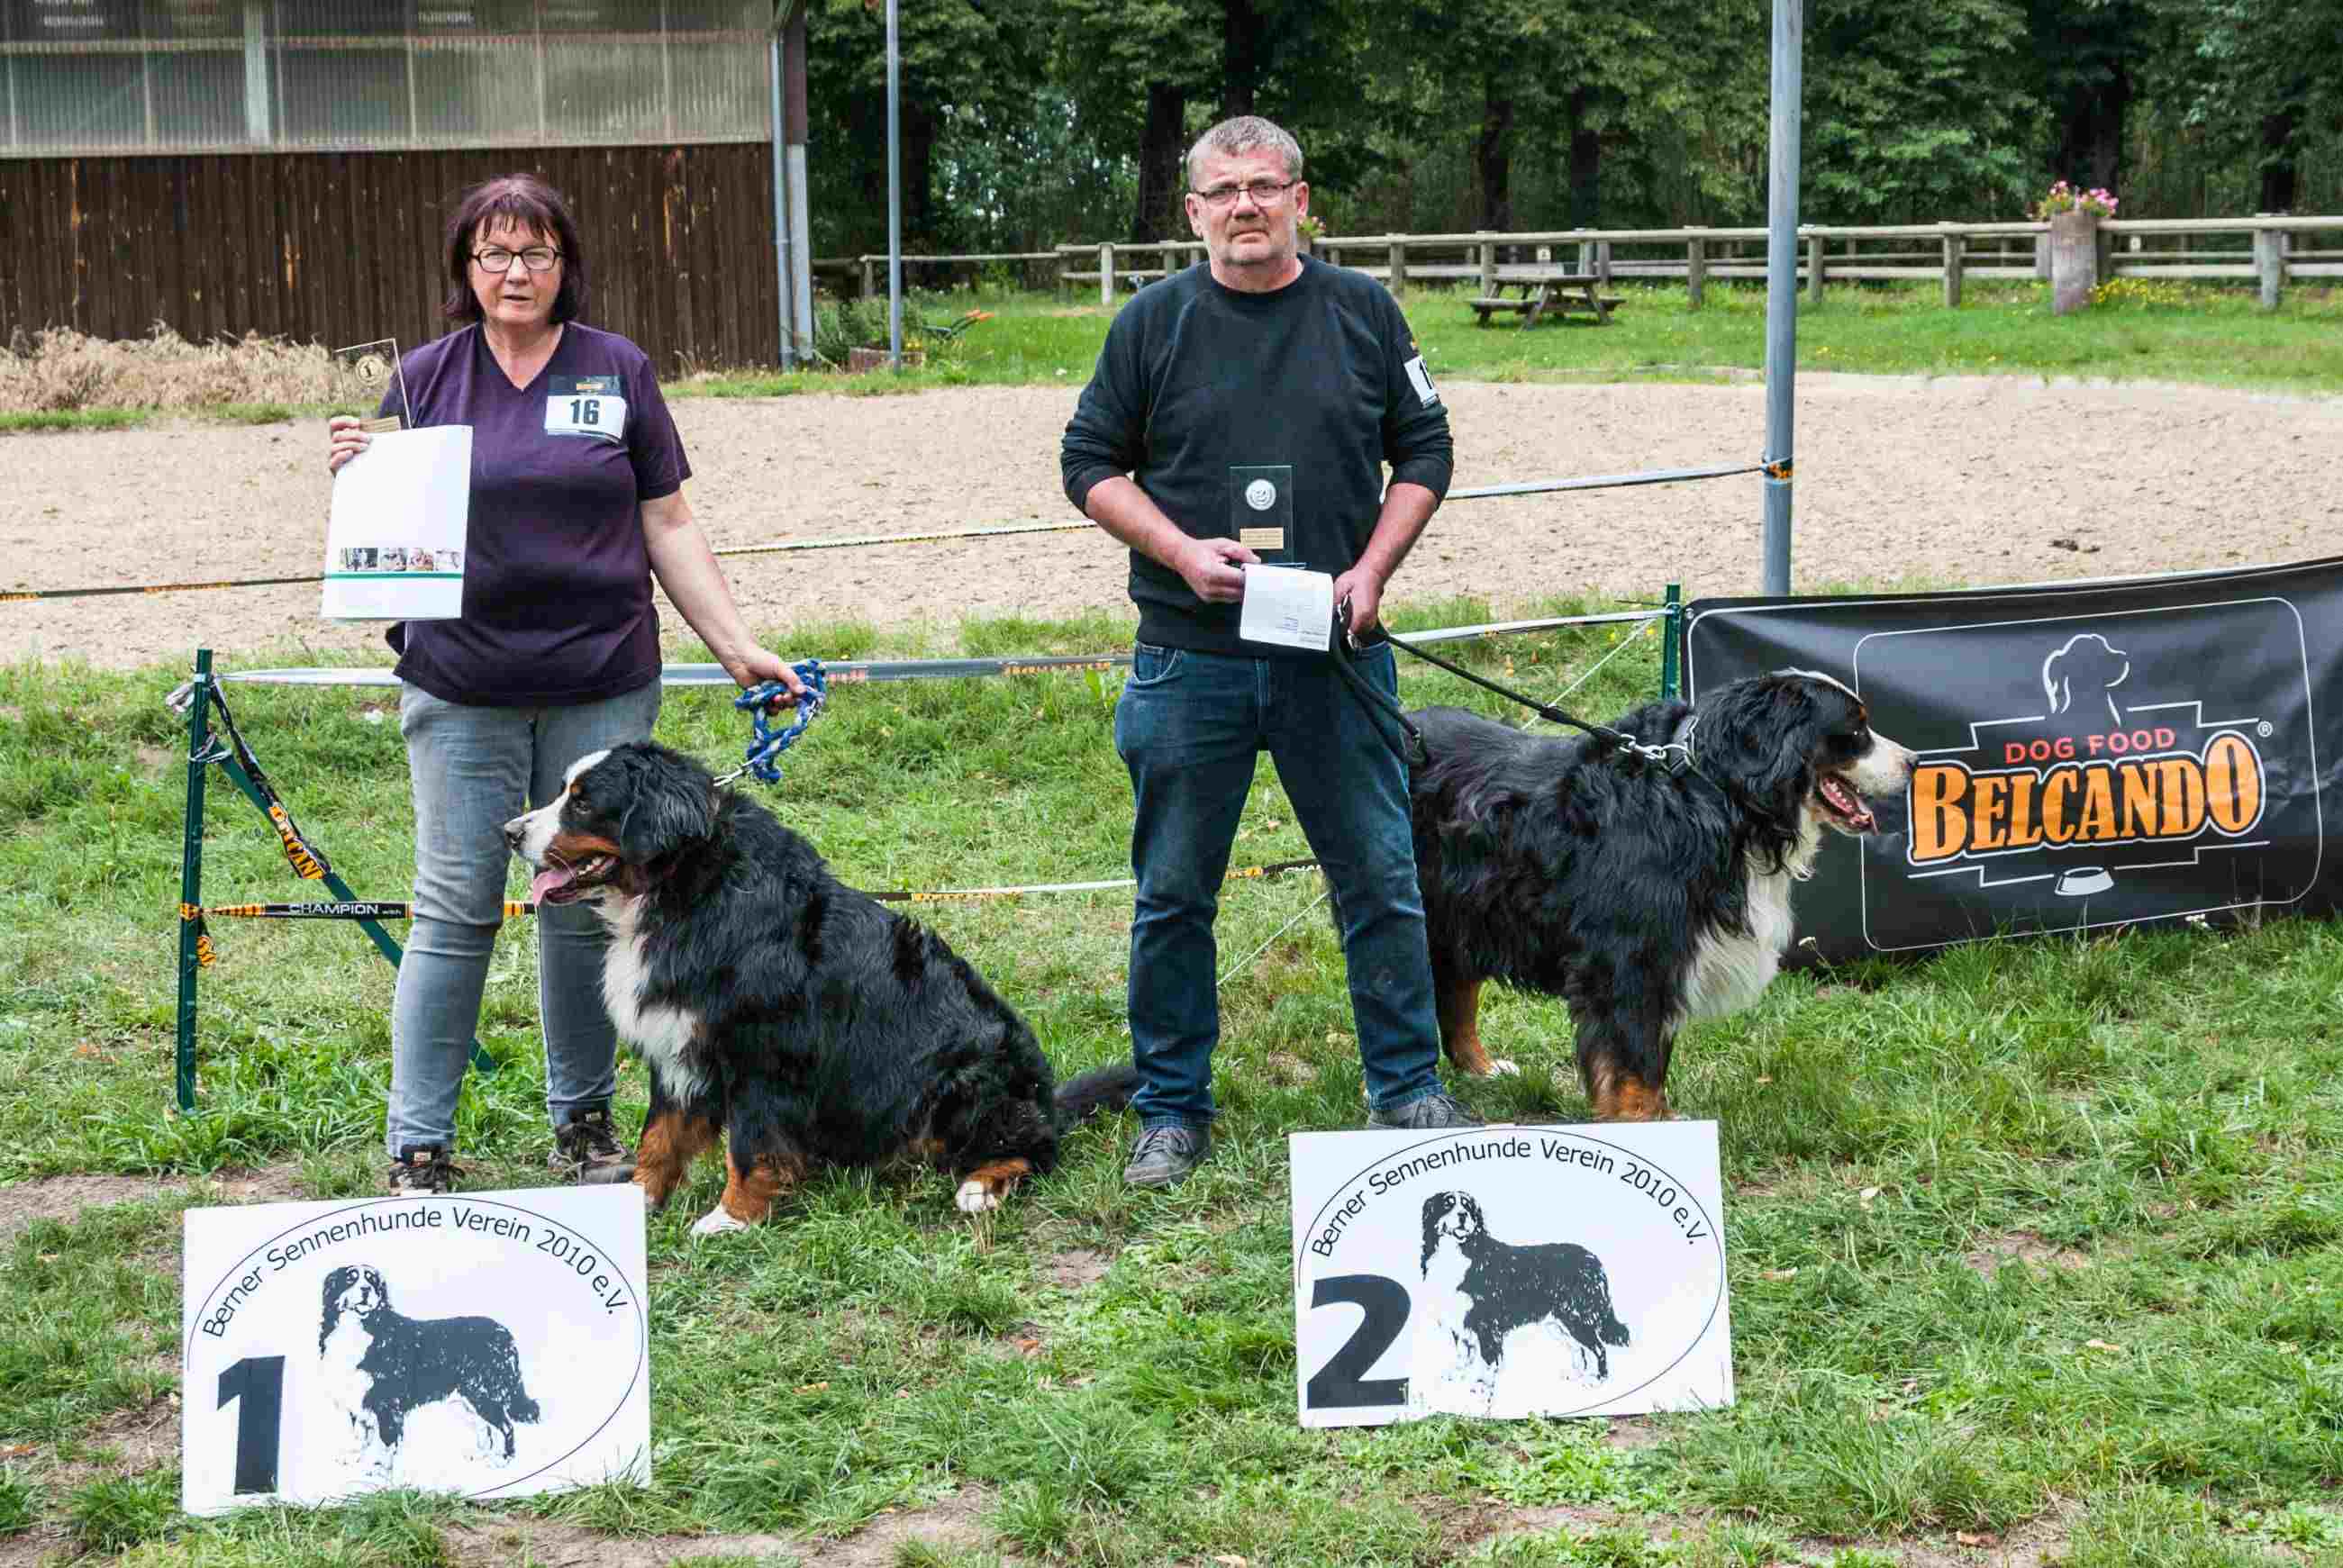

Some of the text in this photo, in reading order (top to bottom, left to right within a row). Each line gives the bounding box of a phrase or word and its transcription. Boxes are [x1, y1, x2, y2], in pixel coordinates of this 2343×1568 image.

[569, 399, 600, 425] 16
[1912, 735, 2261, 862] BELCANDO
[2004, 728, 2176, 765] DOG FOOD
[288, 902, 379, 916] CHAMPION
[1311, 1137, 1708, 1257] Berner Sennenhunde Verein 2010 e.V.
[202, 1206, 629, 1338] Berner Sennenhunde Verein 2010 e.V.
[1306, 1274, 1412, 1409] 2
[217, 1355, 286, 1496] 1
